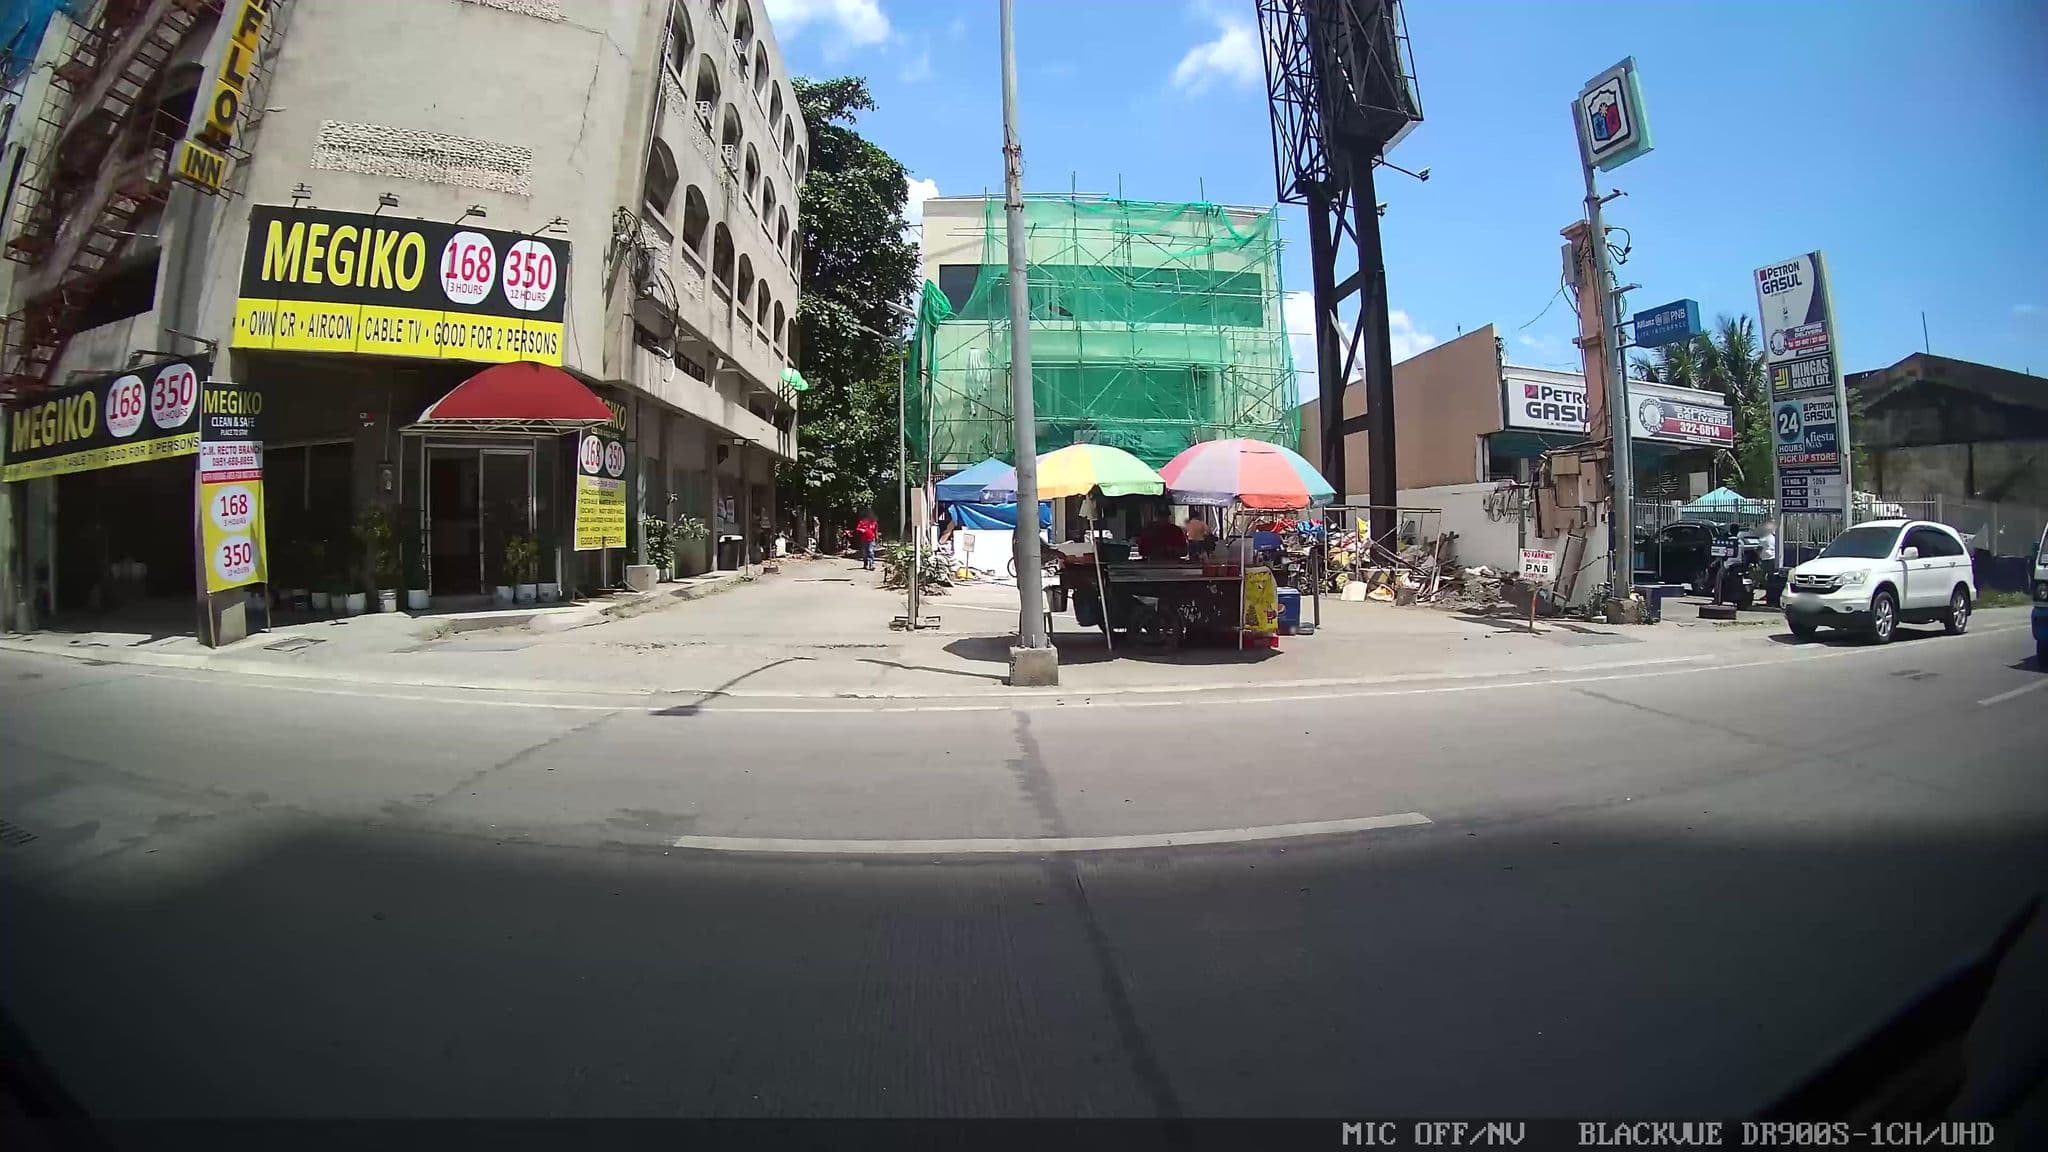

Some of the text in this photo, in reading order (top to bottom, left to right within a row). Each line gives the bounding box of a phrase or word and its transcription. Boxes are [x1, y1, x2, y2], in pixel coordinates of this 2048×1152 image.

[185, 146, 222, 185] INN
[261, 220, 426, 291] MEGIKO
[446, 242, 492, 283] 168
[507, 250, 553, 290] 350
[1767, 261, 1800, 279] PETRON
[450, 283, 483, 295] 3 HOURS
[510, 290, 546, 303] 12 HOURS
[1762, 277, 1802, 295] GASUL
[1671, 308, 1686, 321] PNB
[250, 311, 557, 355] OWN CR AIRCON CABLE TV GOOD FOR 2 PERSONS
[1791, 358, 1829, 379] MINGAS
[110, 383, 142, 420] 168
[153, 372, 193, 411] 350
[203, 390, 262, 414] MEGIKO
[1526, 401, 1589, 422] GASU
[1804, 411, 1834, 422] GASUL
[1809, 401, 1833, 412] PETRON
[12, 391, 97, 453] MEGIKO
[211, 416, 232, 427] CLEAN
[240, 417, 255, 427] SAFE
[1780, 413, 1799, 434] 24
[156, 436, 200, 453] PERSONS
[1810, 431, 1835, 442] fiesta
[239, 445, 261, 455] BRANCH
[585, 440, 601, 466] 168
[609, 444, 622, 470] 350
[1779, 444, 1803, 452] HOURS
[1780, 452, 1837, 464] PICK UP STORE
[220, 494, 248, 517] 168
[223, 542, 251, 568] 350
[1532, 551, 1552, 559] PARKING
[1525, 564, 1548, 573] PNB
